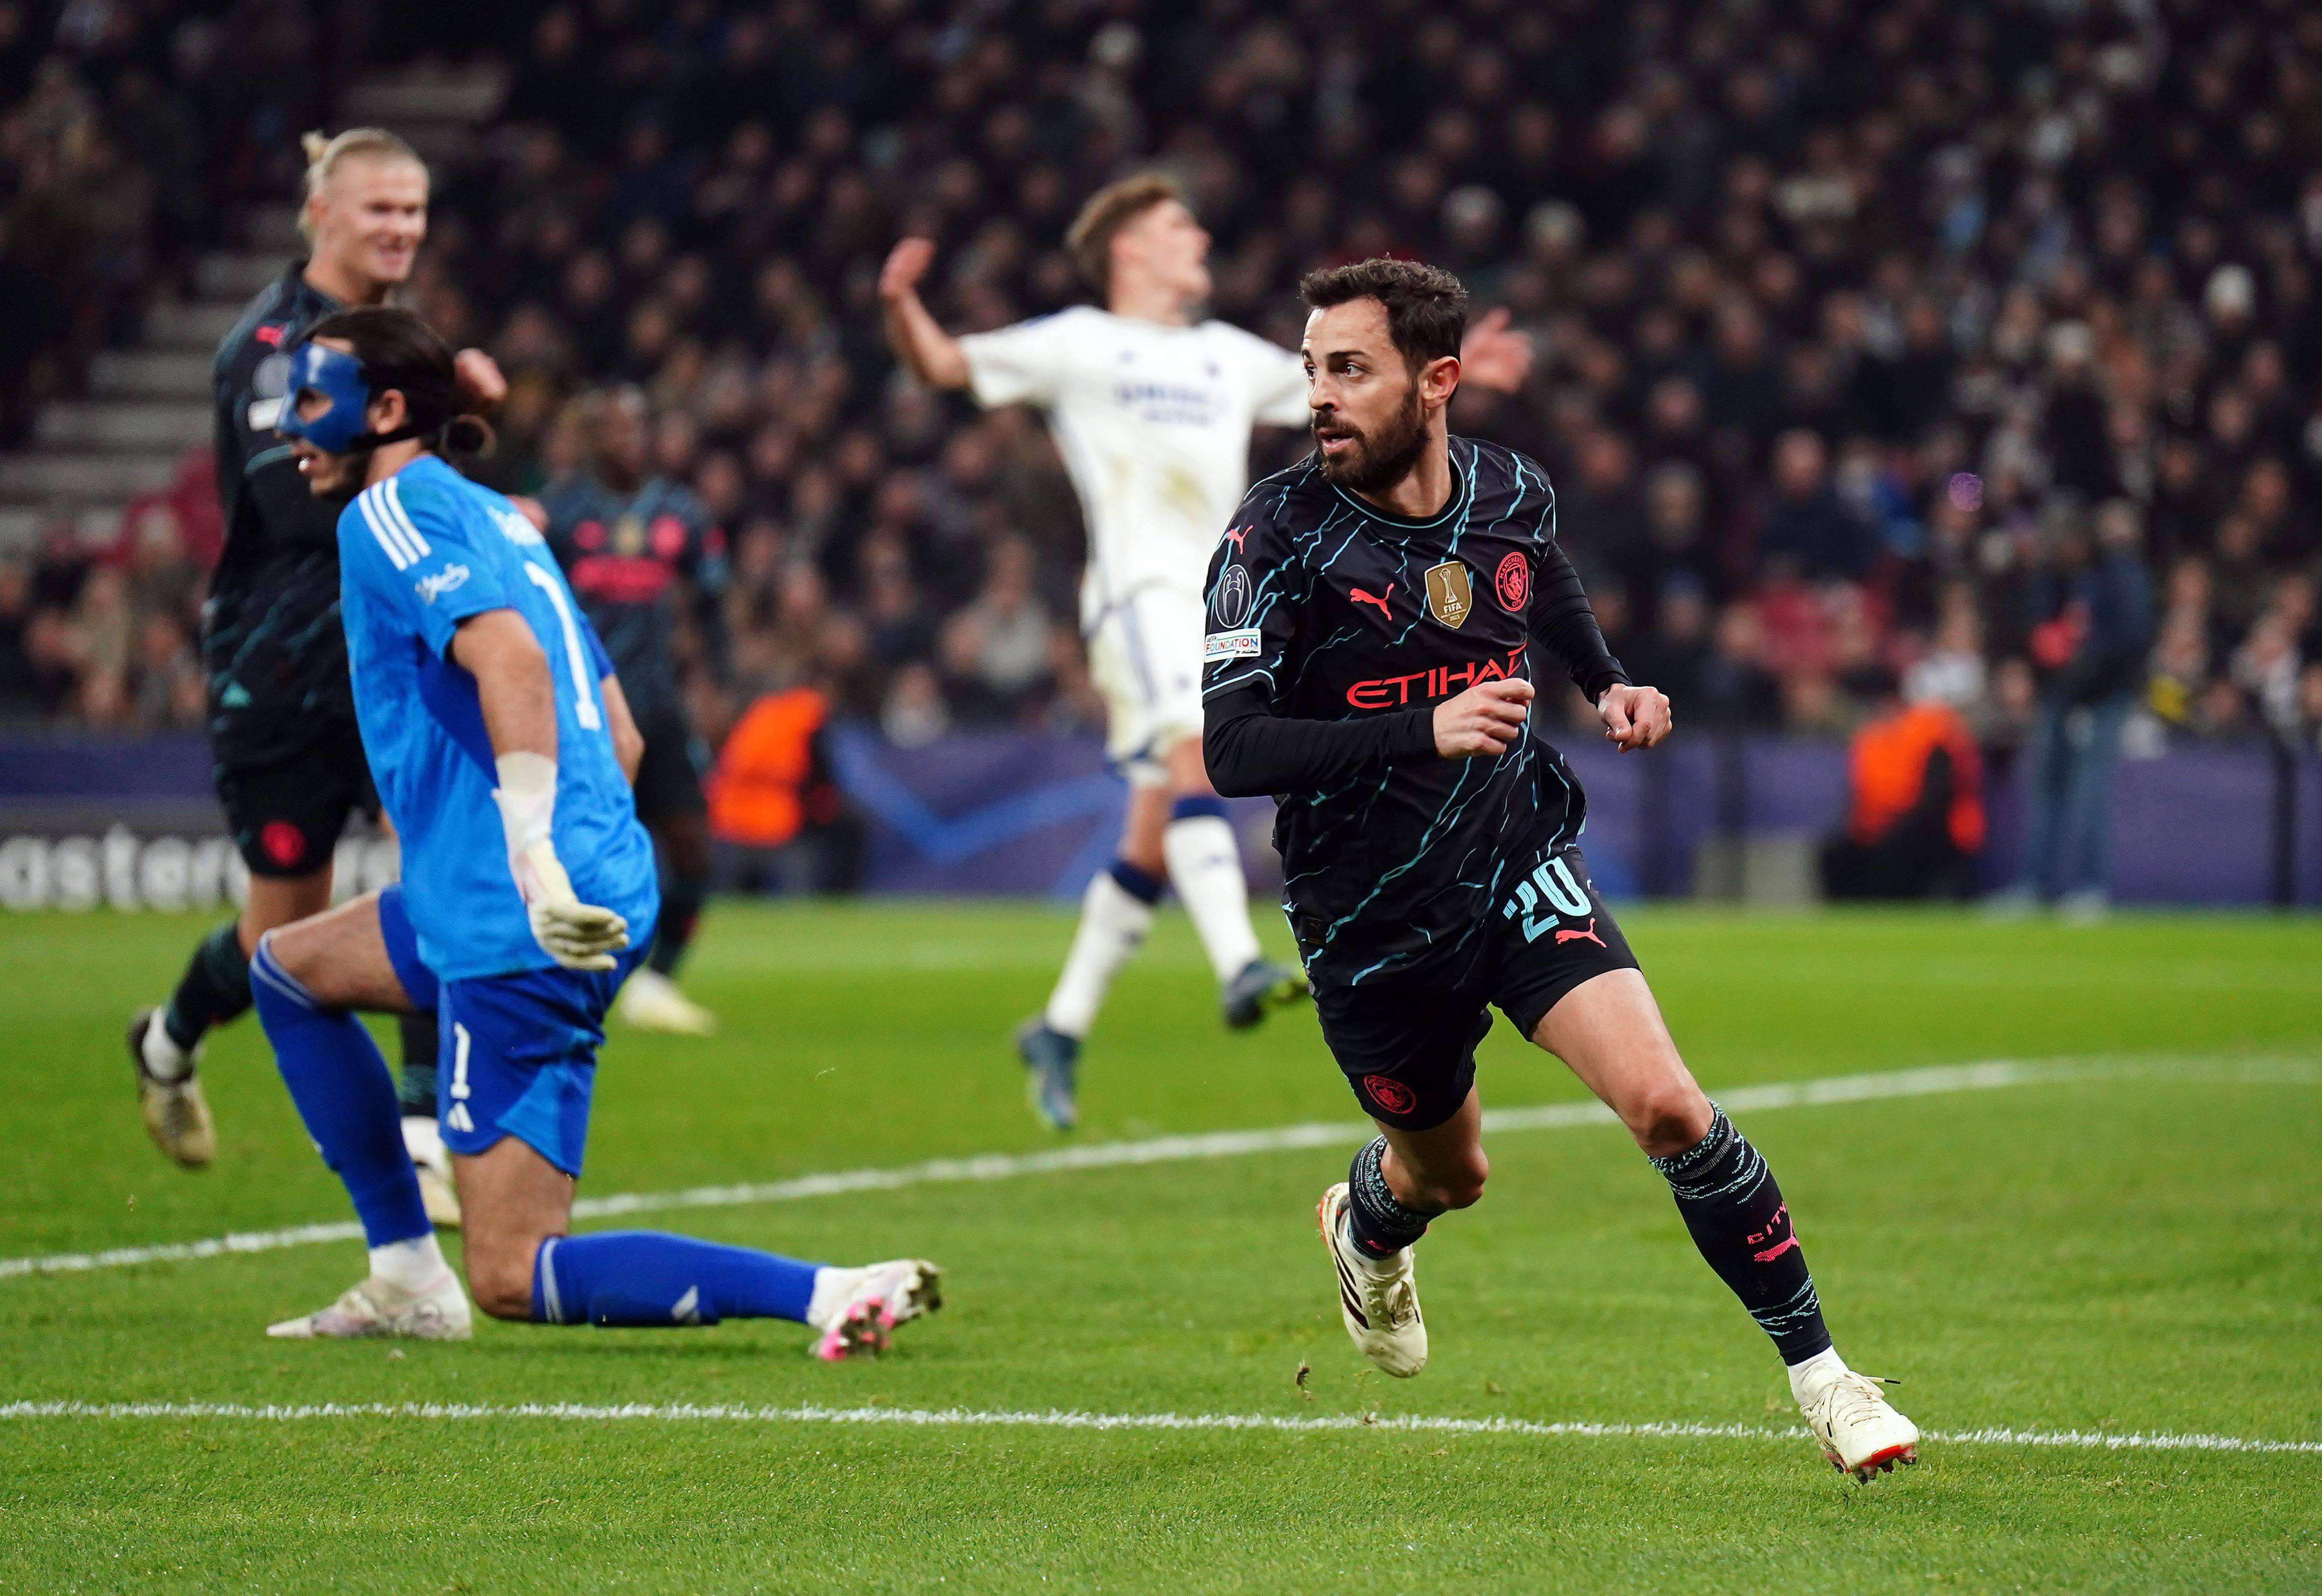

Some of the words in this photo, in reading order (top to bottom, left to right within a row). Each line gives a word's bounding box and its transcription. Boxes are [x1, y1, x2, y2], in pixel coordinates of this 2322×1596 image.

[523, 560, 601, 731] 1
[1206, 638, 1258, 653] FOUNDATION
[1443, 602, 1462, 614] FIFA
[1503, 856, 1592, 943] 20
[450, 1021, 471, 1099] 1
